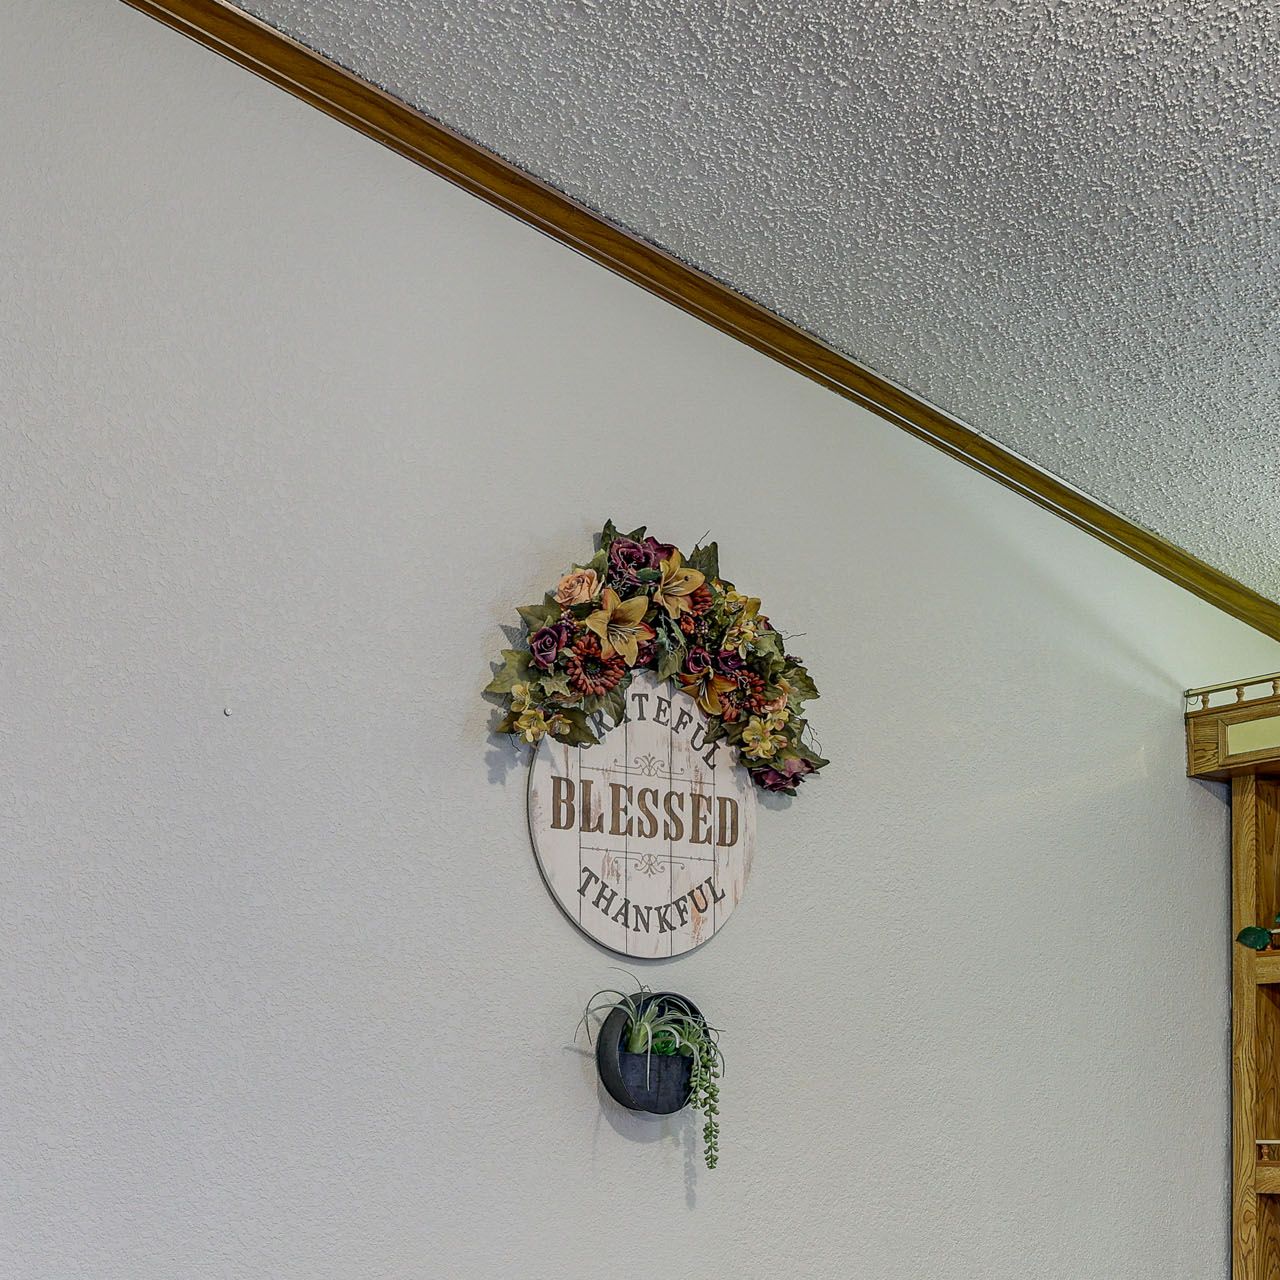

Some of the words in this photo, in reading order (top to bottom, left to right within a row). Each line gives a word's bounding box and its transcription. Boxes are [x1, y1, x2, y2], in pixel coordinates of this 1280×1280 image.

[578, 693, 721, 771] RTEFUL
[550, 775, 739, 848] BLESSED
[577, 866, 726, 934] THANKFUL
